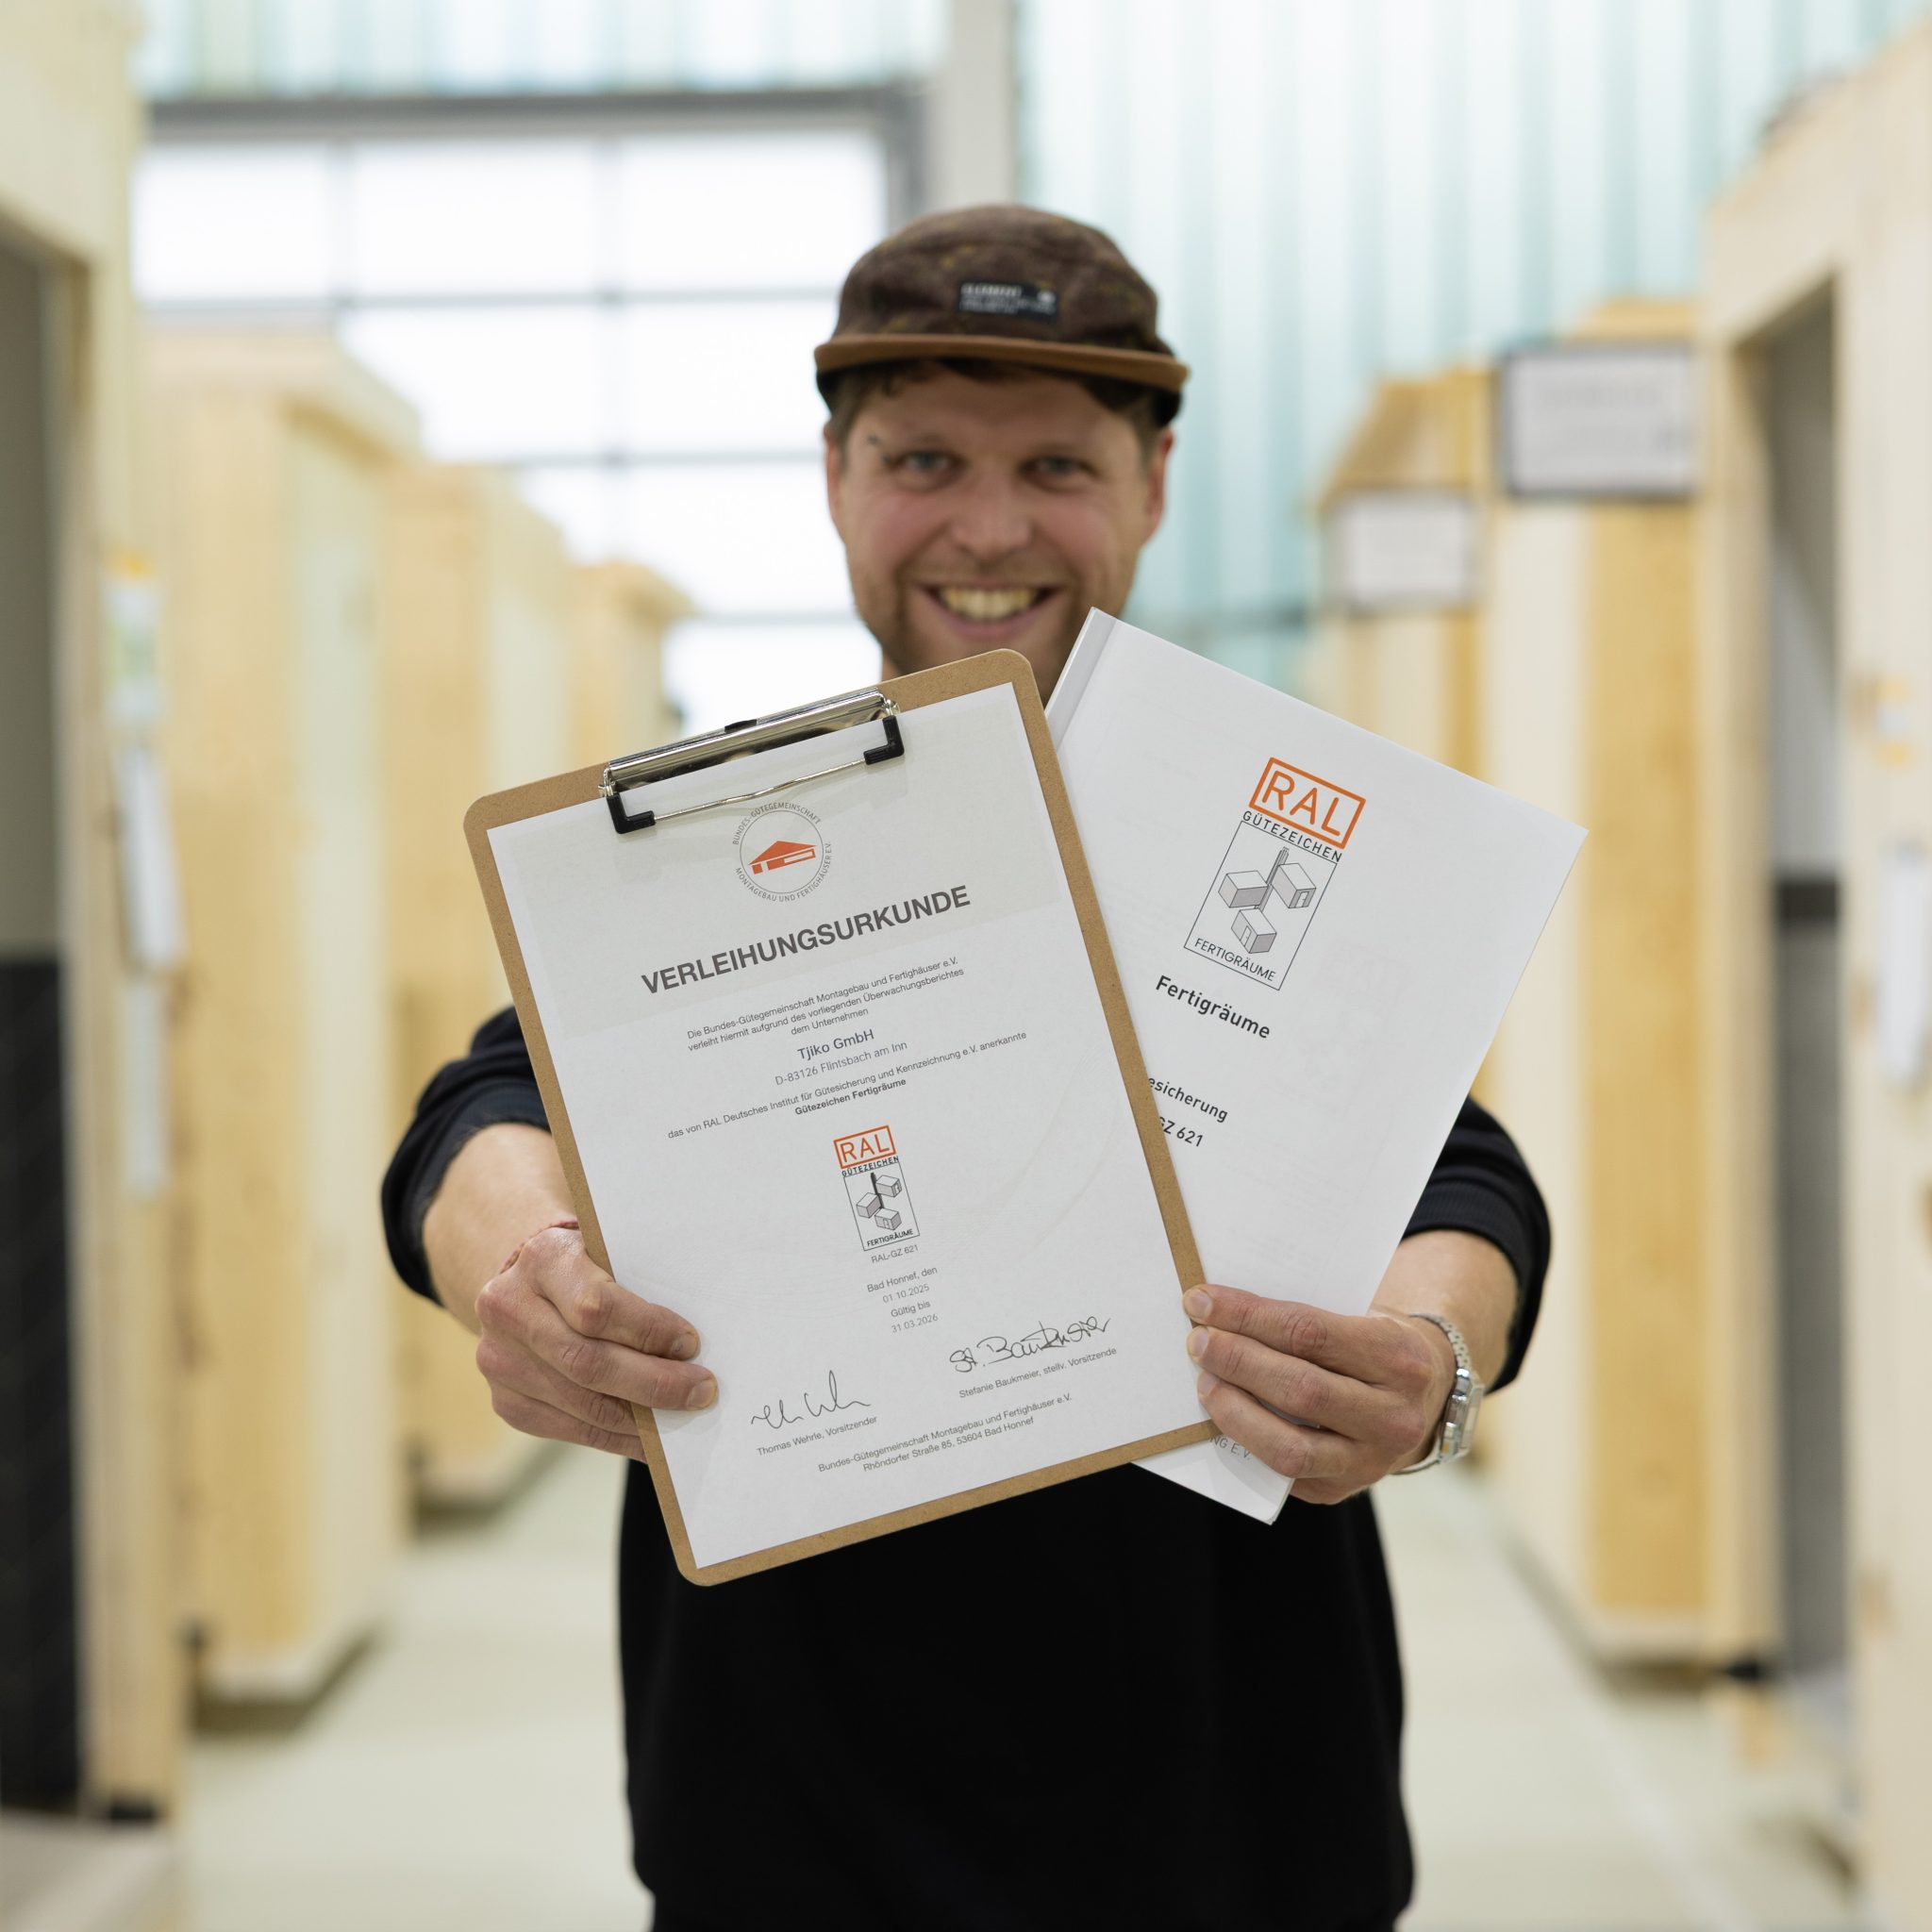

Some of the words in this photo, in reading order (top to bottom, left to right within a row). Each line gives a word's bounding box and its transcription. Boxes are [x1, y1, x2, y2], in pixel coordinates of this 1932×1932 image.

[732, 802, 821, 845] BUNDES-GÜTEGEMEINSCHAFT
[1261, 770, 1341, 837] RAL
[1241, 810, 1342, 862] GÜTEZEICHEN
[736, 867, 777, 902] MONTAGEBAU
[778, 893, 796, 903] UND
[796, 854, 831, 898] FERTIGHÄUSER
[641, 884, 970, 993] VERLEIHUNGSURKUNDE
[1194, 938, 1275, 981] FERTIGRÄUME
[687, 1030, 702, 1039] Die
[703, 996, 814, 1034] Bundes-Gütegemeinschaft
[816, 983, 869, 1002] Montagebau
[871, 975, 887, 987] und
[889, 962, 940, 982] Fertighäuser
[942, 957, 958, 967] e.V.
[688, 1037, 719, 1051] verleiht
[720, 1027, 749, 1041] hiermit
[751, 1016, 789, 1033] aufgrund
[791, 1013, 807, 1023] des
[808, 997, 861, 1017] vorliegenden
[862, 969, 964, 1002] Überwachungsberichtes
[1155, 974, 1270, 1039] Fertigräume
[791, 1024, 809, 1035] dem
[811, 1008, 868, 1028] Unternehmen
[774, 1065, 818, 1085] D-83126
[820, 1051, 872, 1072] Flintsbach
[874, 1047, 889, 1058] am
[891, 1041, 908, 1052] Inn
[796, 1043, 829, 1060] Tjiko
[833, 1028, 874, 1049] GmbH
[668, 1129, 684, 1138] das
[685, 1124, 702, 1133] von
[703, 1117, 722, 1128] RAL
[723, 1105, 768, 1123] Deutsches
[769, 1095, 799, 1109] Institut
[800, 1091, 812, 1101] für
[814, 1074, 876, 1096] Gütesicherung
[877, 1068, 894, 1079] und
[895, 1051, 960, 1074] Kennzeichnung
[962, 1044, 977, 1055] e.V.
[979, 1032, 1026, 1050] anerkannte
[794, 1094, 850, 1114] Gütezeichen
[852, 1079, 906, 1099] Fertigräume
[840, 1133, 890, 1162] RAL
[1176, 1126, 1204, 1147] 621
[841, 1156, 900, 1177] GÜTEZEICHEN
[866, 1229, 913, 1246] FERTIGRÄUME
[871, 1248, 903, 1263] RAL-GZ
[904, 1244, 918, 1254] 621
[866, 1280, 885, 1292] Bad
[886, 1271, 919, 1286] Honnef,
[921, 1267, 937, 1276] den
[882, 1283, 929, 1303] 01.10.2025
[891, 1305, 916, 1317] Gültig
[917, 1300, 930, 1309] bis
[891, 1313, 938, 1332] 31.03.2026
[958, 1383, 993, 1398] Stefanie
[994, 1370, 1041, 1388] Baukmeier,
[1042, 1362, 1066, 1374] stellv.
[1067, 1348, 1116, 1366] Vorsitzende
[757, 1441, 791, 1455] Thomas
[791, 1432, 824, 1445] Wehrle,
[824, 1416, 876, 1436] Vorsitzender
[818, 1434, 929, 1472] Bundes-Gütegemeinschaft
[930, 1420, 983, 1439] Montagebau
[985, 1412, 1002, 1424] und
[1003, 1399, 1054, 1419] Fertighäuser
[1057, 1392, 1072, 1403] e.V.
[862, 1453, 908, 1472] Rhöndorfer
[911, 1444, 940, 1457] Straße
[941, 1439, 955, 1449] 85,
[956, 1431, 982, 1444] 53604
[984, 1425, 1002, 1437] Bad
[1003, 1415, 1033, 1431] Honnef
